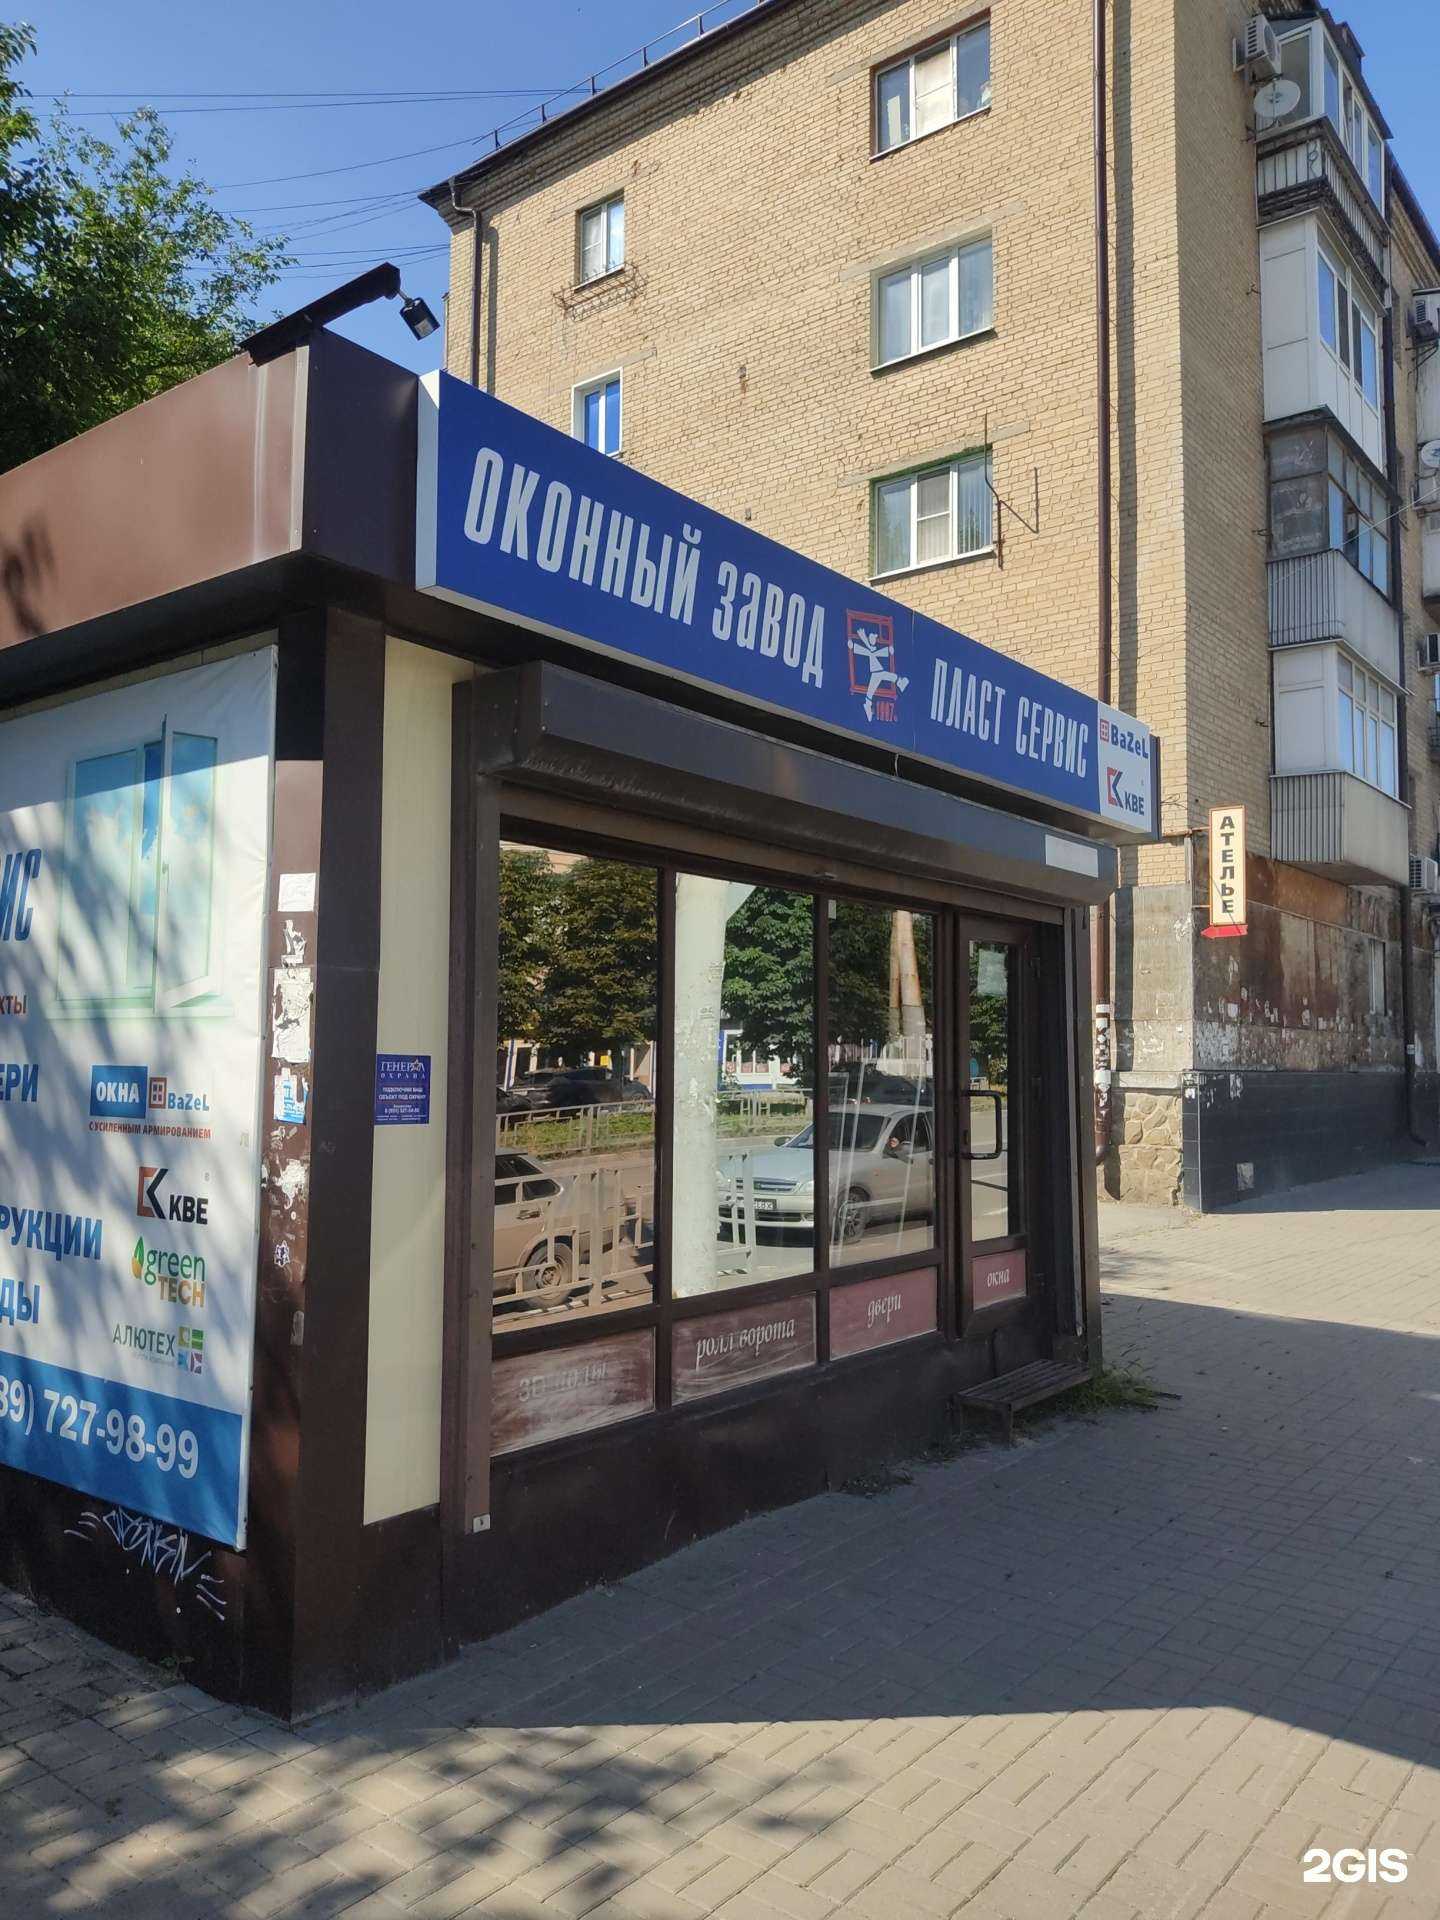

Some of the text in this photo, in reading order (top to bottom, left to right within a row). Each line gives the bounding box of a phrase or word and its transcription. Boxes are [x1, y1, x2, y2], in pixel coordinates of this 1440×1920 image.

[464, 446, 702, 626] ОКОННЫЙ
[930, 657, 1090, 779] ПЛАСТ СЕРВИС
[1219, 815, 1236, 914] АТЕЛЬЕ
[95, 1081, 140, 1104] ОКНА
[94, 1121, 141, 1135] УСИЛЕННЫМ
[142, 1125, 212, 1139] АРМИРОВАНИЕМ
[144, 1249, 206, 1286] green
[986, 1268, 1010, 1288] окна
[157, 1275, 206, 1308] TECH
[867, 1293, 902, 1329] двери
[113, 1322, 176, 1358] АЛЮТЕХ
[739, 1318, 795, 1357] ворота
[44, 1388, 200, 1480] 727-98-99
